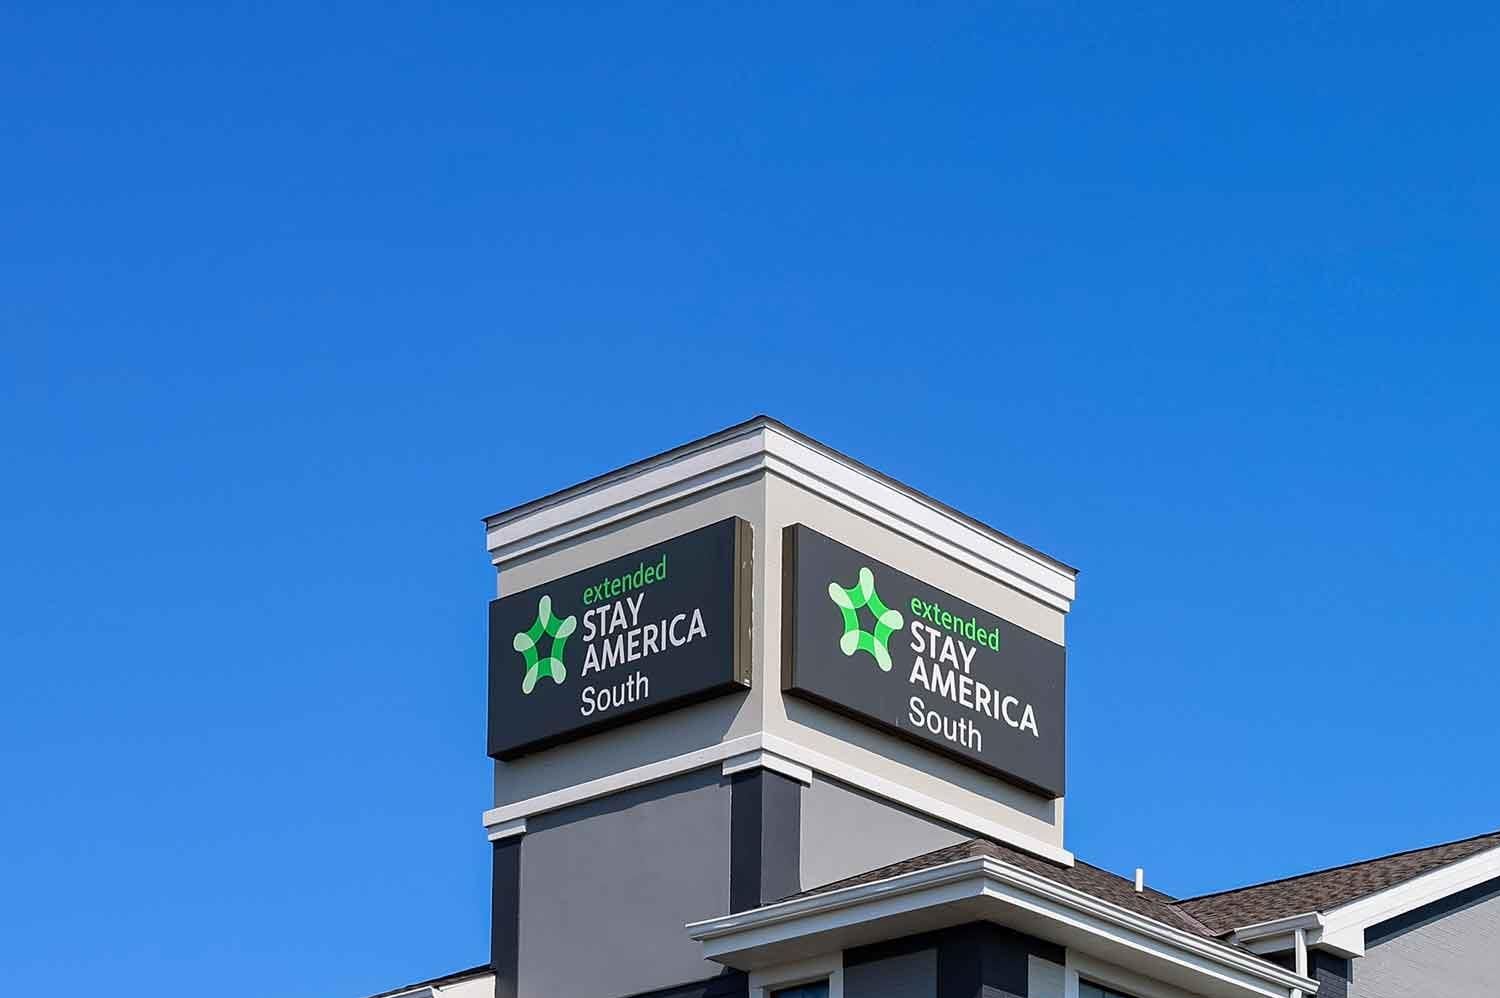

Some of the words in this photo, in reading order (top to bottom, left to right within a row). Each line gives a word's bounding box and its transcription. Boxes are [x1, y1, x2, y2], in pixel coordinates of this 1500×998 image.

[583, 554, 667, 605] extended
[581, 608, 707, 677] AMERICA
[583, 592, 644, 642] STAY
[911, 597, 1000, 651] extended
[910, 620, 977, 674] STAY
[580, 671, 649, 716] South
[909, 655, 1039, 737] AMERICA
[909, 696, 982, 752] South
